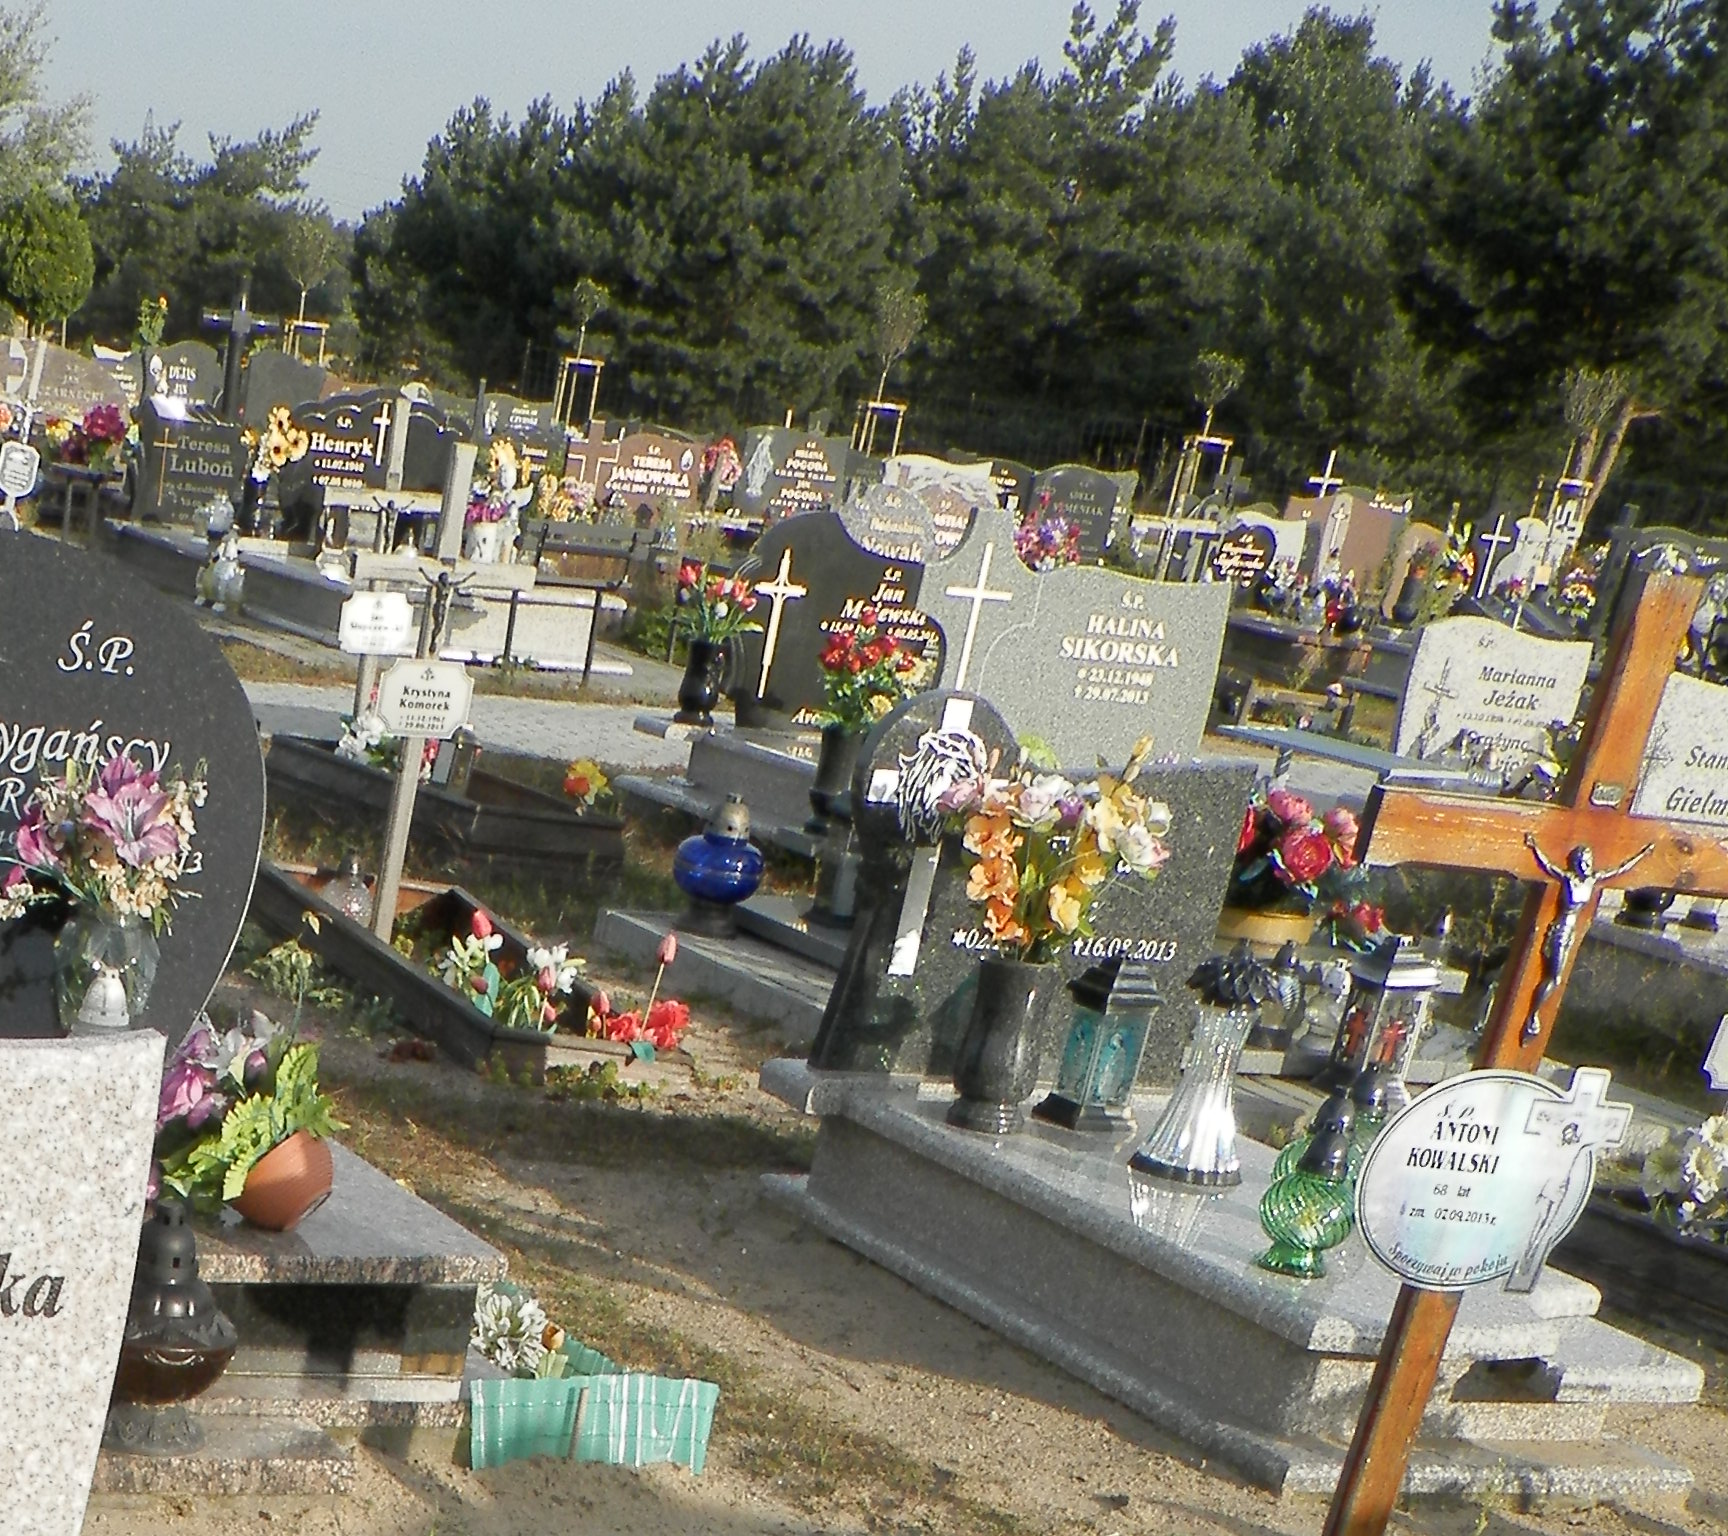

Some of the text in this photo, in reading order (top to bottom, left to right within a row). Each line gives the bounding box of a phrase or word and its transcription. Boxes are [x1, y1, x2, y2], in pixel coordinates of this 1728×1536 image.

[177, 434, 231, 455] Teresa
[309, 431, 374, 459] Henryk
[870, 582, 907, 603] Jan
[1086, 613, 1166, 640] HALINA
[57, 619, 135, 676] Ś.P.
[1058, 636, 1179, 668] SIKORSKA
[1478, 665, 1558, 689] Marianna
[399, 698, 450, 711] Komorek
[402, 686, 451, 699] Krystyna
[1482, 689, 1540, 711] Jeżak
[1684, 745, 1728, 769] Stan
[1665, 785, 1728, 817] Gielm
[1431, 1120, 1500, 1146] ANTONI
[1406, 1147, 1500, 1175] KOWALSKI
[1432, 1184, 1449, 1196] 68
